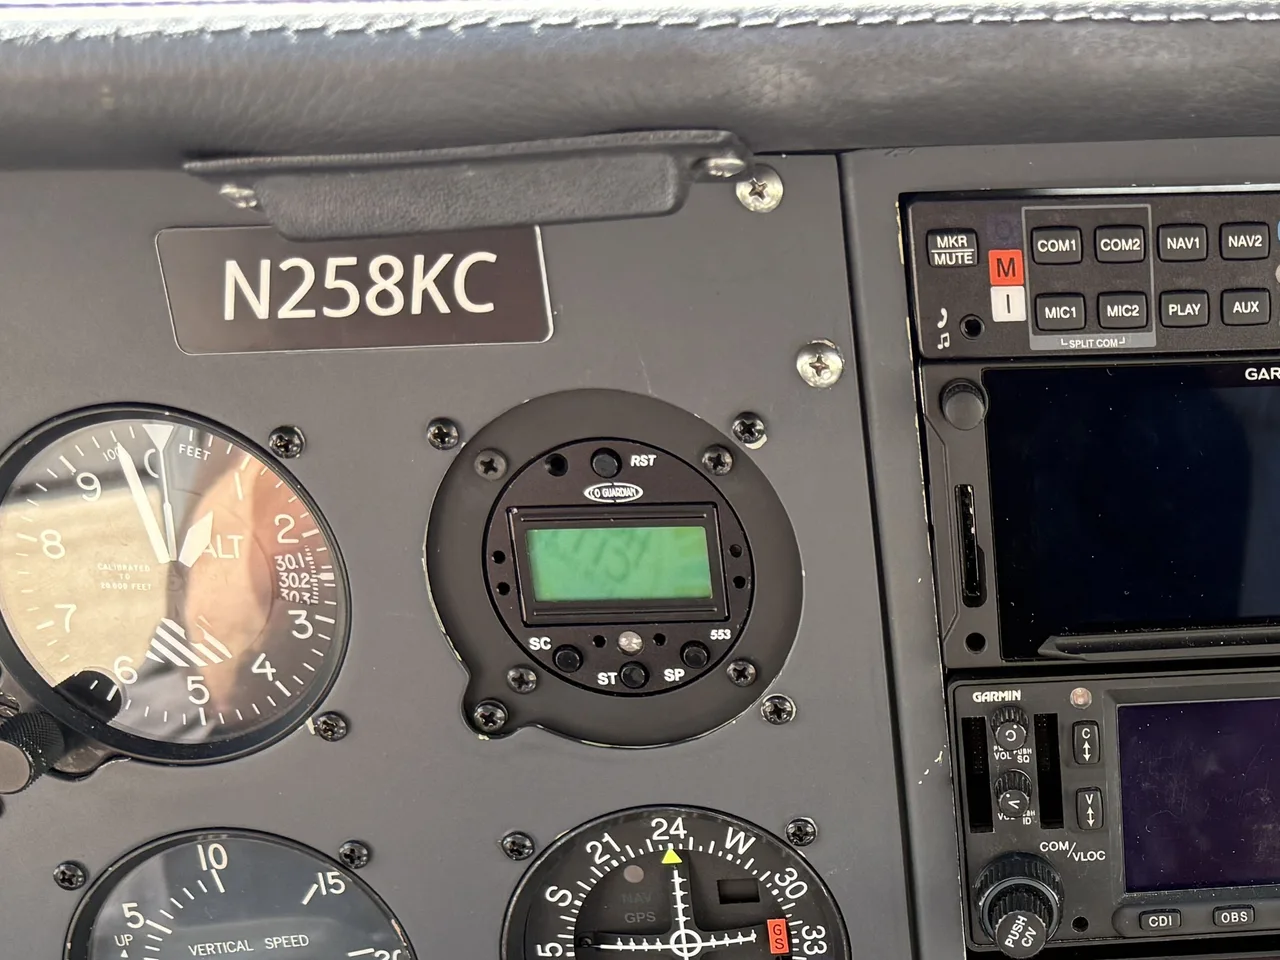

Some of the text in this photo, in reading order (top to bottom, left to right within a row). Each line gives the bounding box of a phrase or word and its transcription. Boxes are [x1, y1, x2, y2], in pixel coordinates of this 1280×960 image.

[937, 236, 968, 248] MKR
[1038, 239, 1076, 252] COM1
[1100, 239, 1141, 251] COM2
[1167, 237, 1200, 249] NAV1
[1228, 235, 1262, 248] NAV2
[934, 253, 973, 265] MUTE
[222, 251, 498, 322] N258KC
[1045, 307, 1077, 319] MIC1
[1169, 304, 1201, 316] PLAY
[1233, 301, 1259, 314] AUX
[1069, 339, 1118, 349] SPLIT COM
[179, 444, 211, 460] FEET
[630, 455, 656, 466] RST
[602, 488, 636, 497] GUARDIAN
[274, 515, 298, 544] 2
[289, 610, 314, 639] 3
[710, 630, 731, 639] 553
[529, 638, 551, 649] SC
[598, 673, 617, 684] ST
[664, 669, 685, 681] SP
[188, 676, 210, 705] 5
[973, 690, 1021, 702] GARMIN
[651, 817, 687, 840] 24
[197, 843, 228, 871] 10
[317, 872, 346, 895] 15
[1149, 916, 1173, 927] CDI
[1221, 911, 1247, 923] OBS
[115, 934, 133, 947] UP
[188, 935, 309, 956] VERTICAL SPEED
